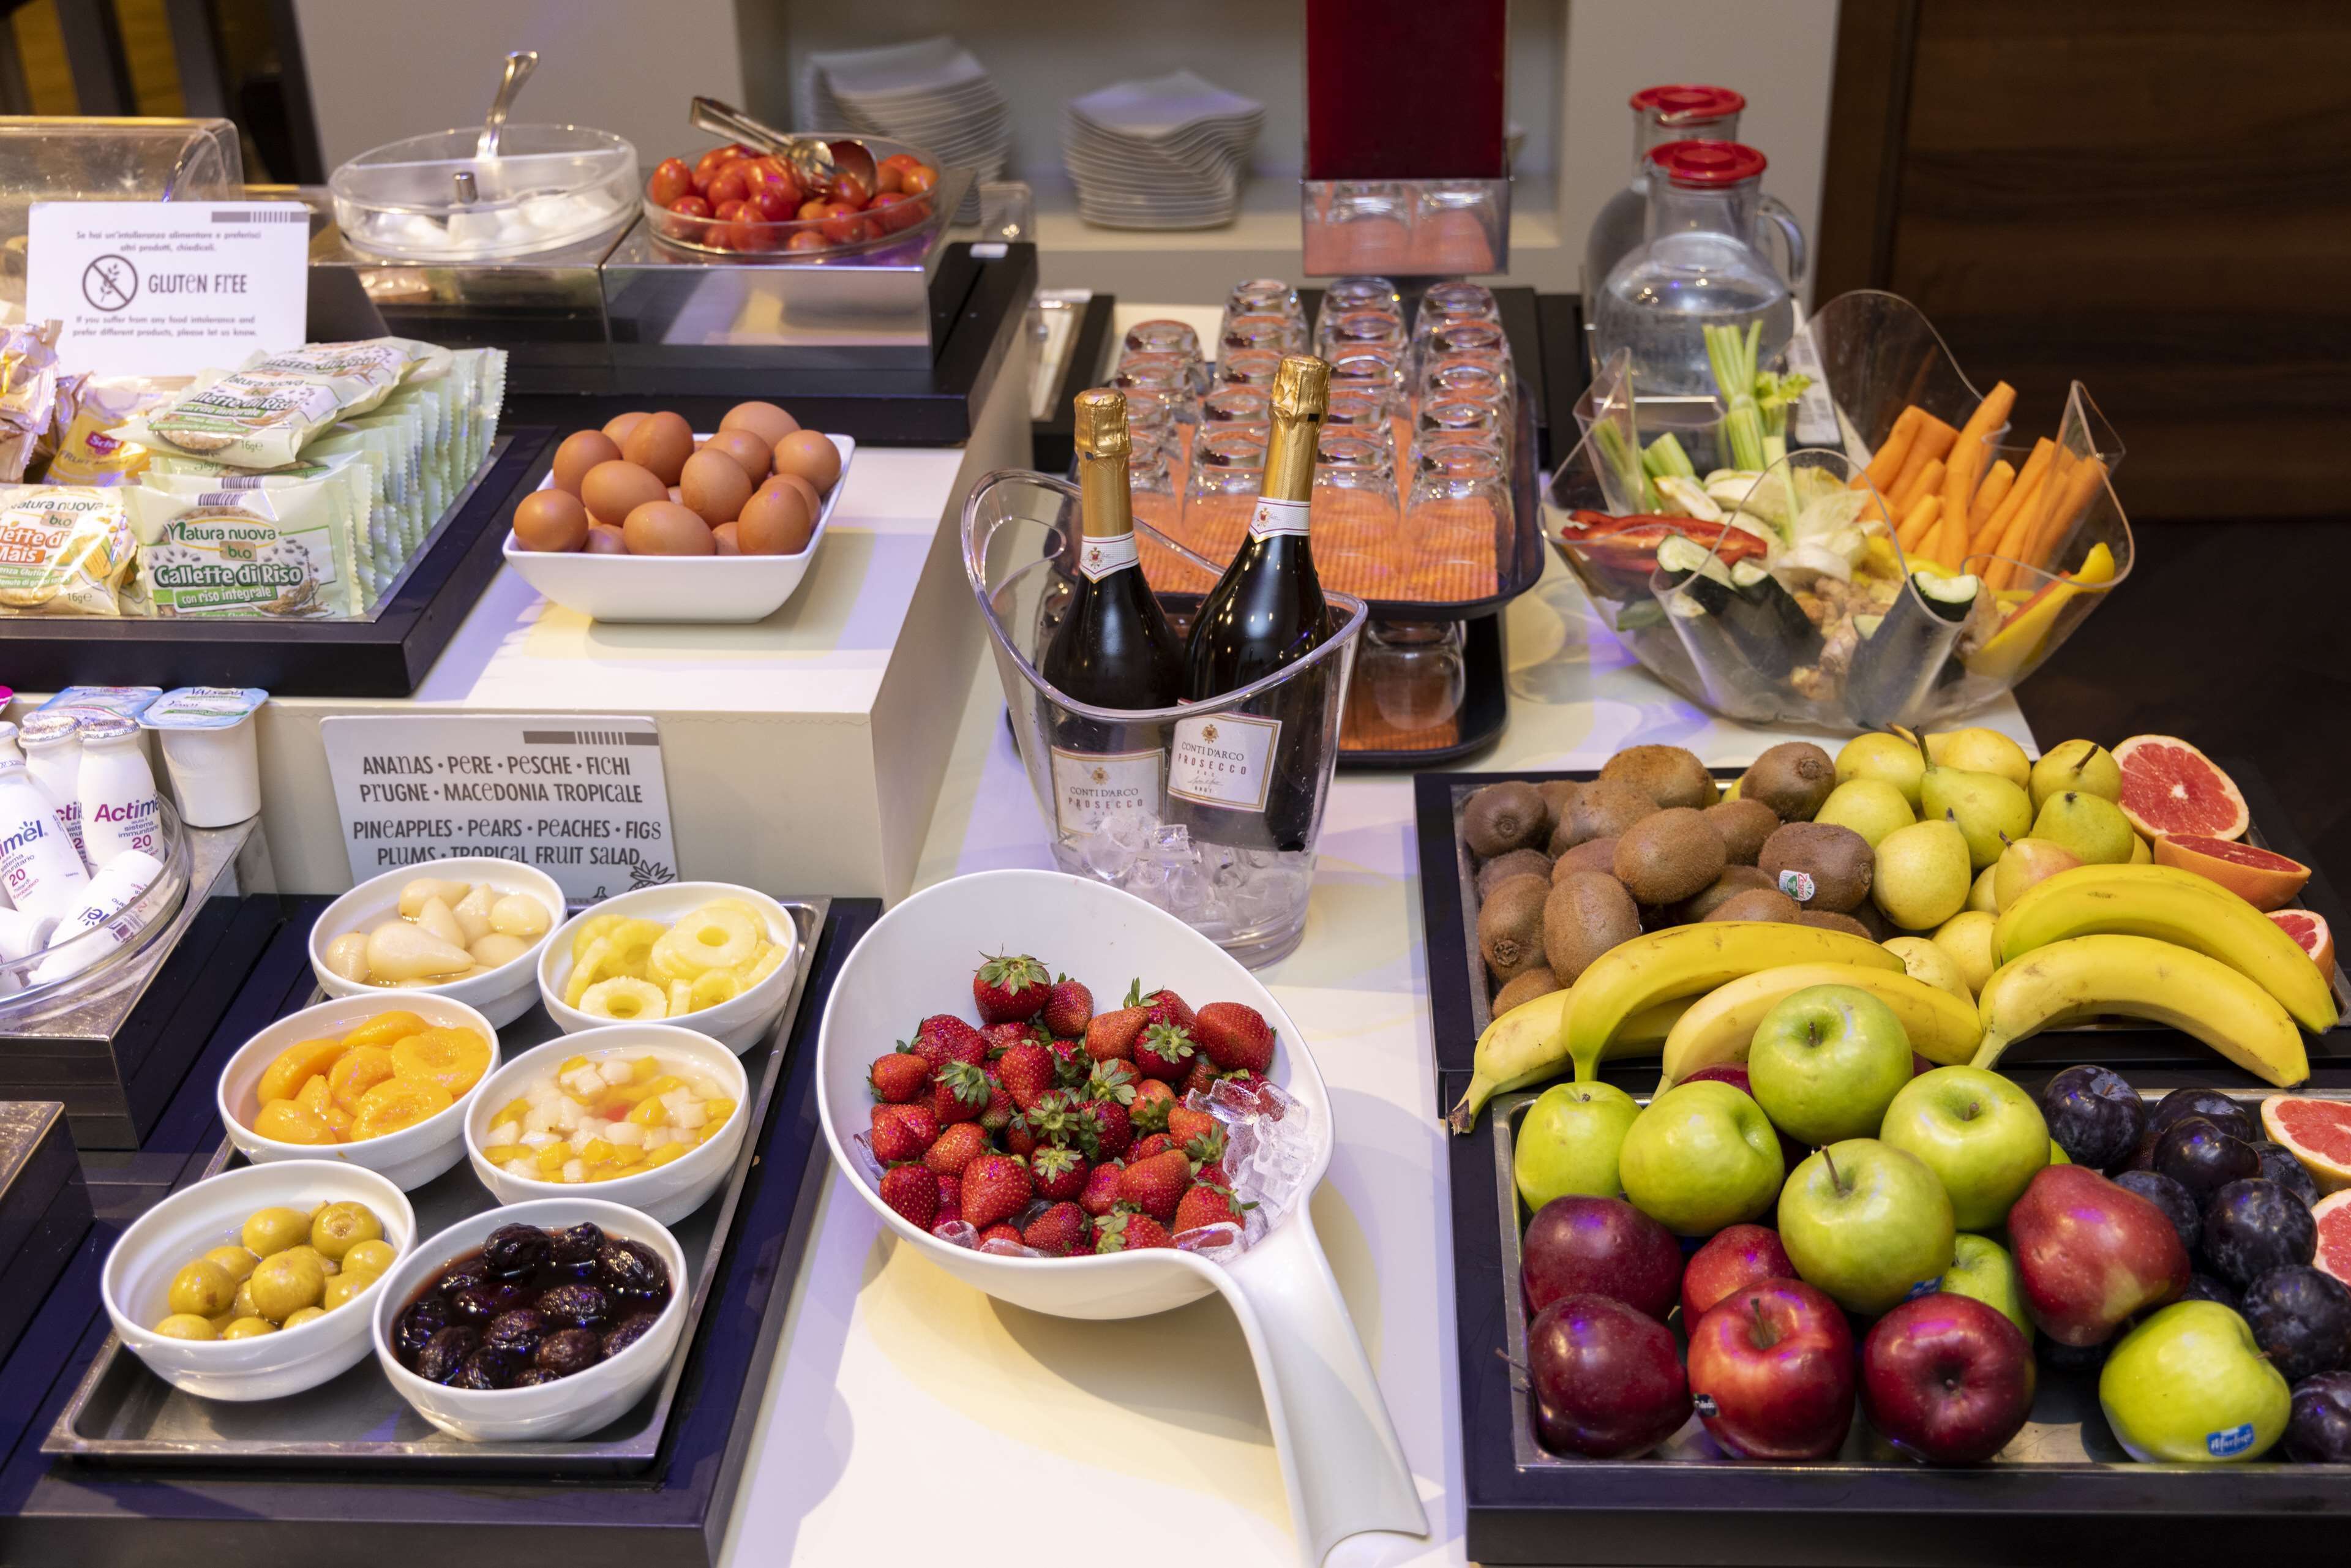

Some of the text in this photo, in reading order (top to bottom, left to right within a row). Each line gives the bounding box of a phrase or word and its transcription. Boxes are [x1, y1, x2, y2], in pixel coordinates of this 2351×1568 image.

[103, 315, 126, 323] suffer
[191, 315, 235, 323] intolerance
[72, 328, 97, 337] prefer
[99, 327, 134, 336] different
[176, 328, 204, 337] please
[207, 328, 218, 336] let
[228, 528, 276, 541] nuova
[155, 564, 303, 585] Gallette di Riso
[182, 587, 272, 604] con riso integrale
[1181, 741, 1205, 755] CONTI
[1178, 752, 1247, 775] PROSECCO
[1070, 786, 1098, 797] CONTI
[1068, 797, 1144, 809] PROSECCO
[124, 820, 154, 832] sistema
[132, 834, 152, 850] 20
[9, 868, 26, 887] 20
